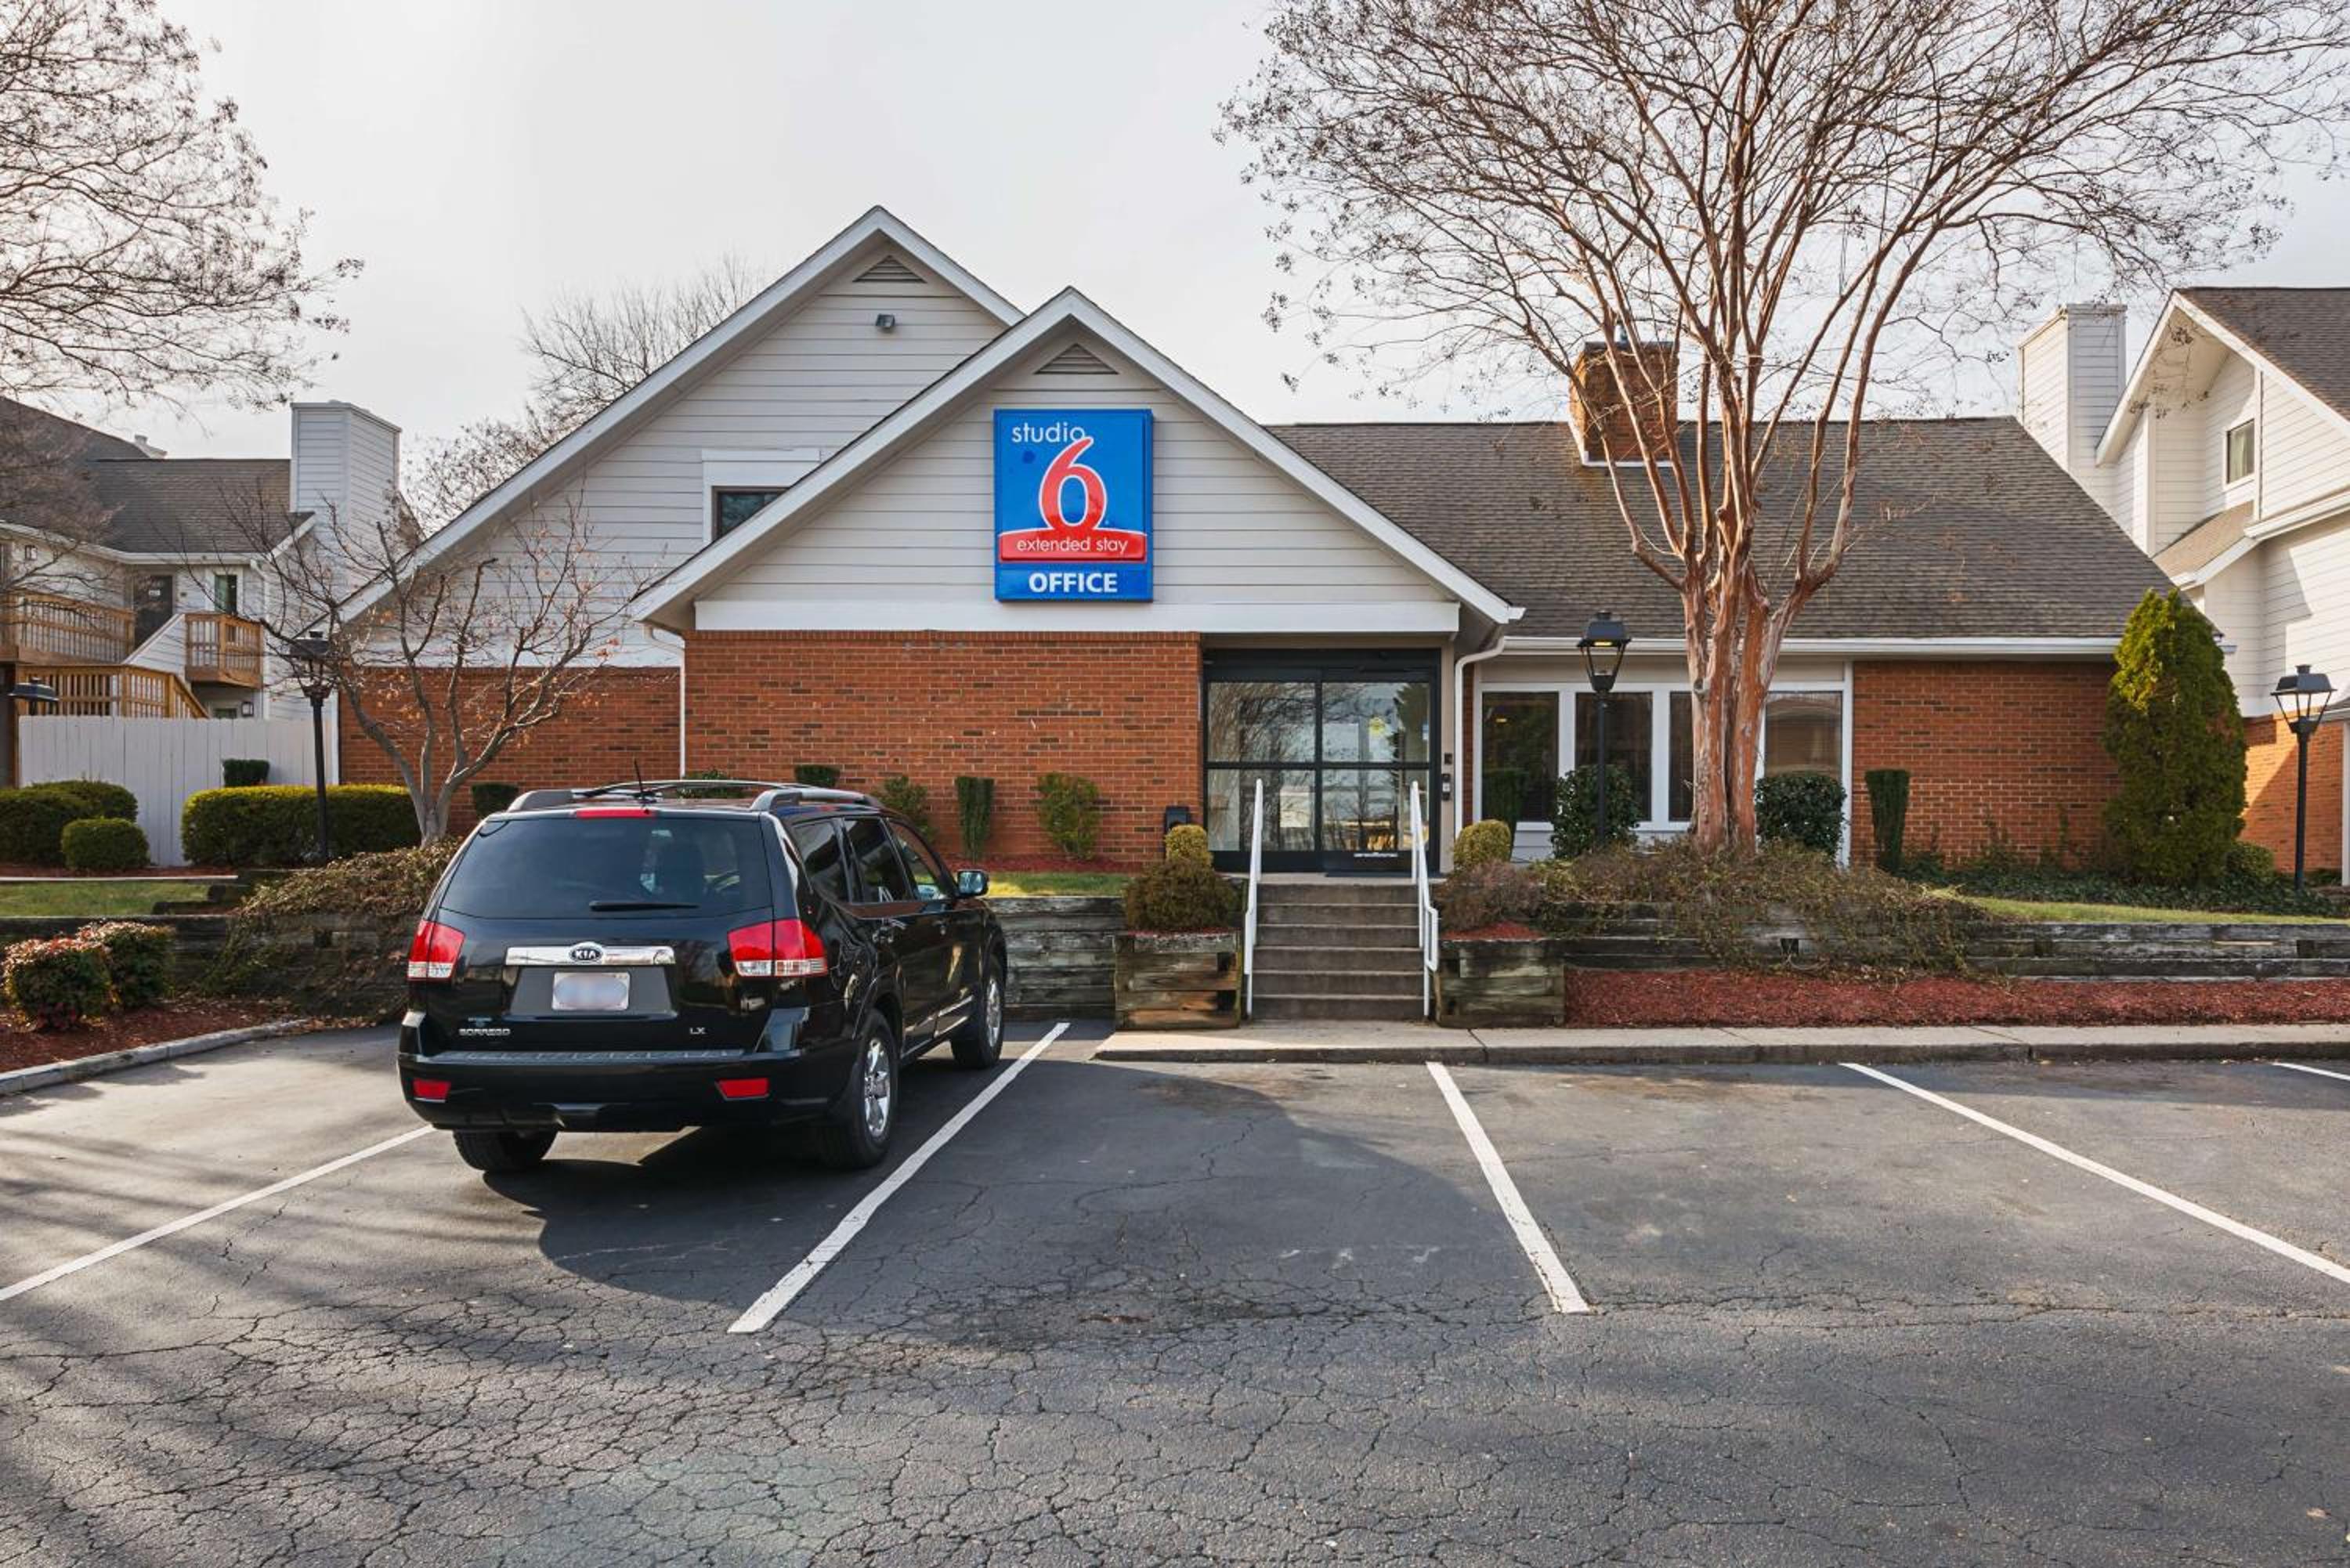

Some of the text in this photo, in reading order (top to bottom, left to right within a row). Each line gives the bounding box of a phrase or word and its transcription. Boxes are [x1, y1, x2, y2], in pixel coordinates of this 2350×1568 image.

[1012, 422, 1086, 443] studio
[1039, 436, 1107, 529] 6
[1017, 537, 1128, 555] extended stay
[1029, 573, 1118, 593] OFFICE
[576, 949, 596, 959] KIA
